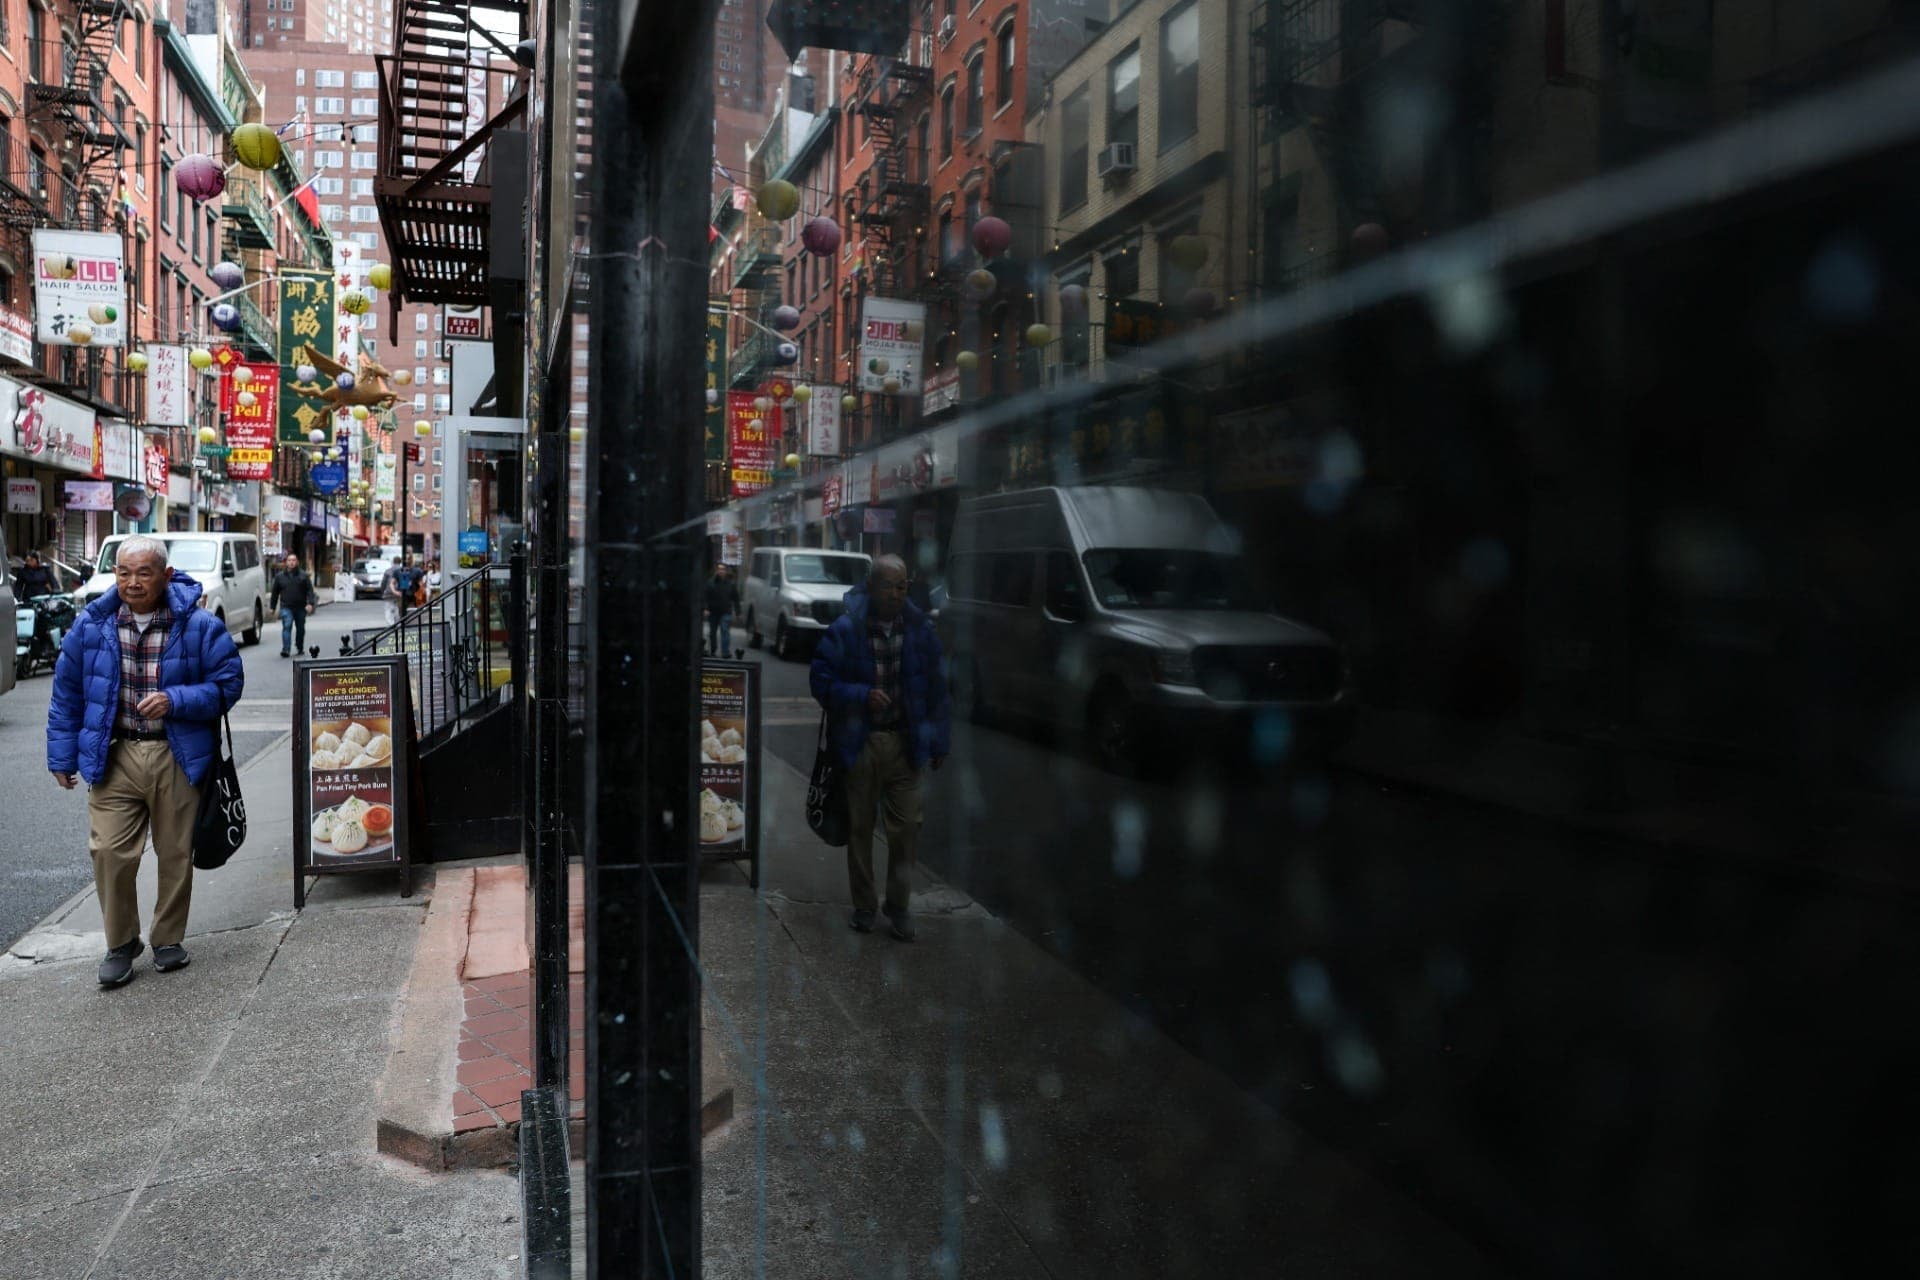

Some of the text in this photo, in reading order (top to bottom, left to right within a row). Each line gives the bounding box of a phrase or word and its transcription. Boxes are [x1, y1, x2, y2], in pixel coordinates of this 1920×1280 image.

[40, 281, 118, 292] HAIR SALON
[337, 677, 364, 685] ZAGAT
[324, 686, 378, 696] JOE'S GINGER
[316, 784, 328, 792] Pan
[328, 784, 344, 792] Fried
[344, 783, 357, 792] Tiny
[358, 782, 371, 790] Pork
